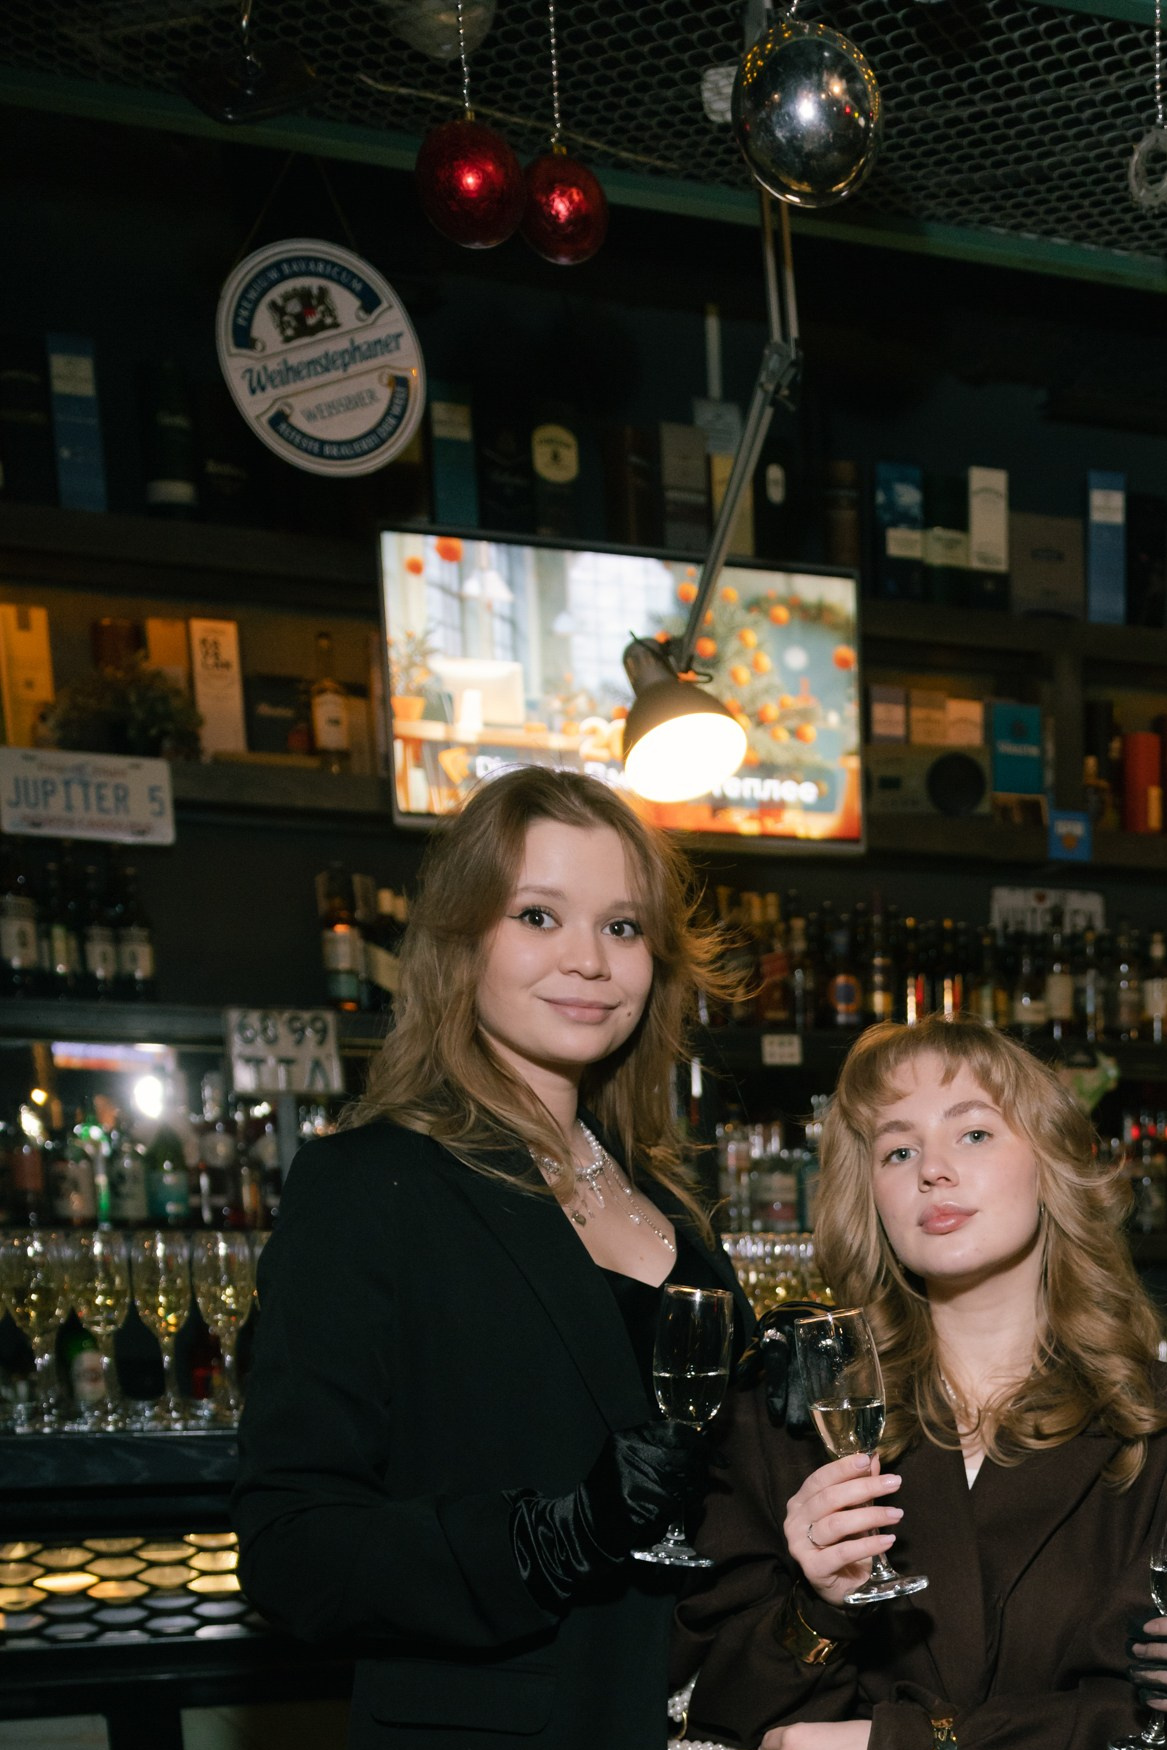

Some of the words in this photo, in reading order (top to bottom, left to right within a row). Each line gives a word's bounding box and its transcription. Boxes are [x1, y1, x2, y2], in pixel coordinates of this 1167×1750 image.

[280, 257, 363, 292] BAVARICUM
[241, 329, 405, 396] Weihenstephaner
[6, 774, 130, 815] JUPITER
[147, 784, 166, 817] 5
